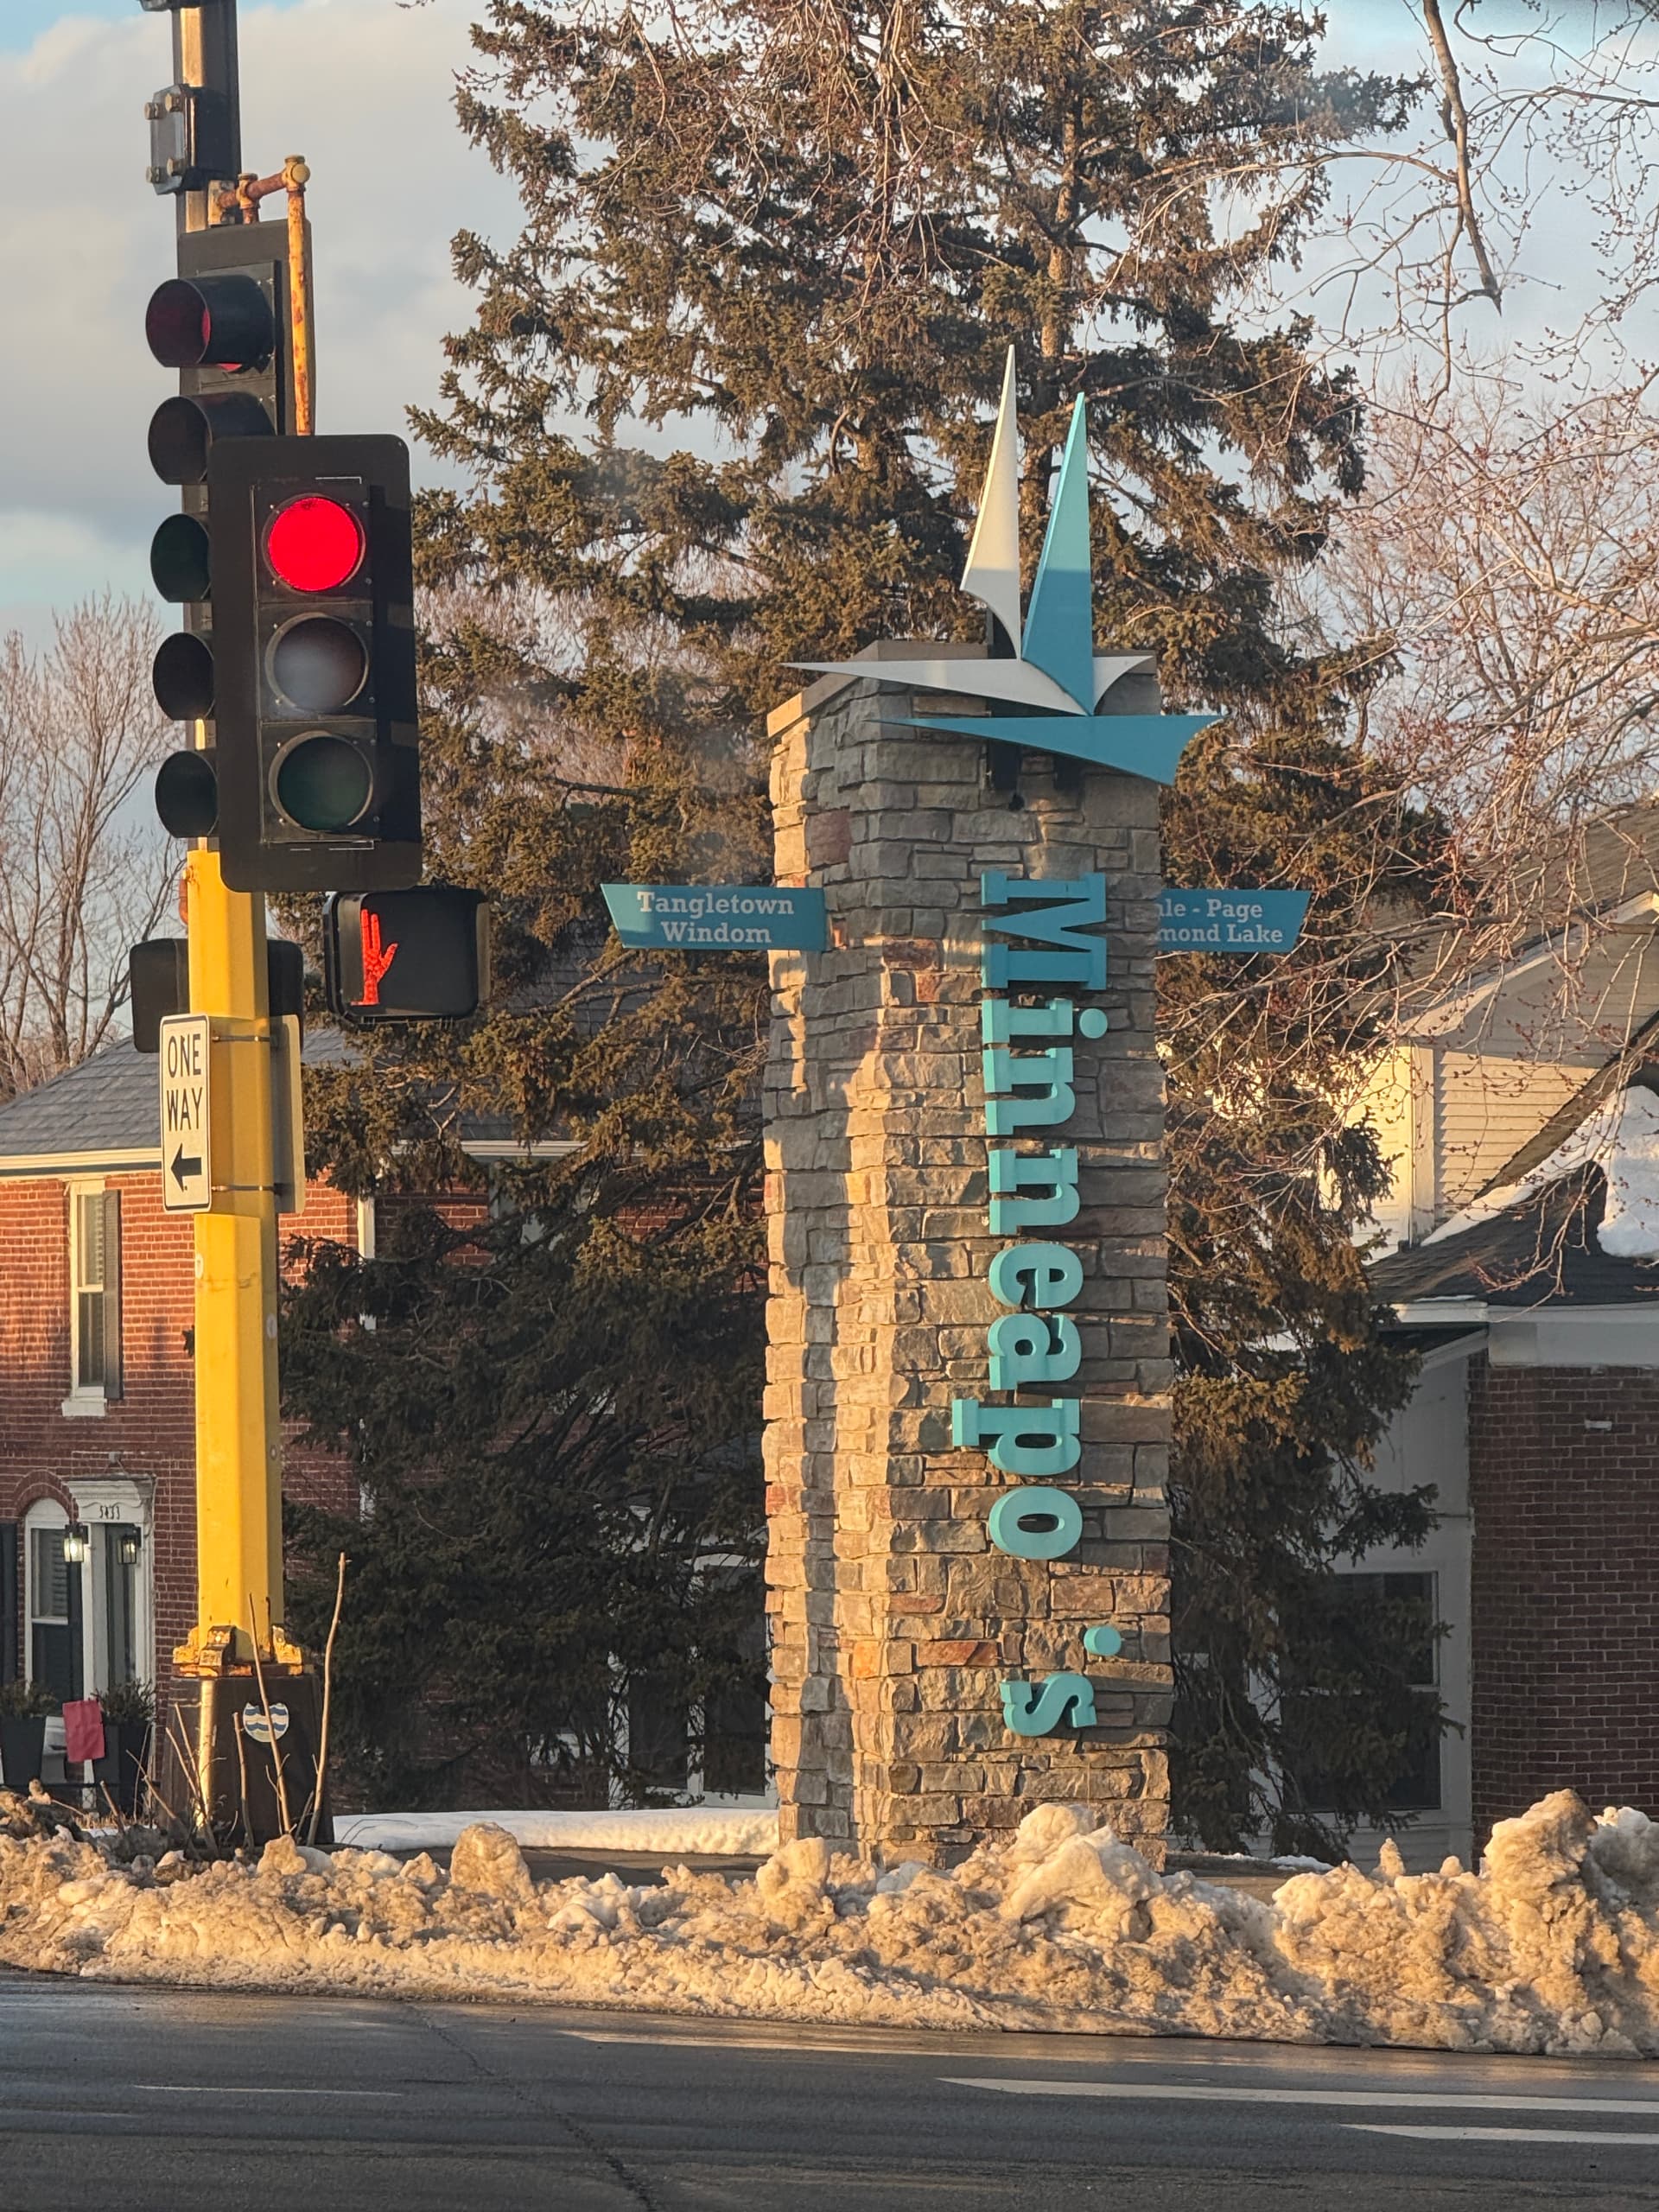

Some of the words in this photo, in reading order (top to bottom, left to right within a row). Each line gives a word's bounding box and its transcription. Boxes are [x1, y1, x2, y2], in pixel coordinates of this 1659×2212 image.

[637, 891, 794, 919] Tangletown
[1206, 899, 1263, 923] Page
[661, 921, 772, 943] Windom
[1227, 925, 1283, 943] Lake
[168, 1033, 201, 1078] ONE
[167, 1086, 203, 1132] WAY
